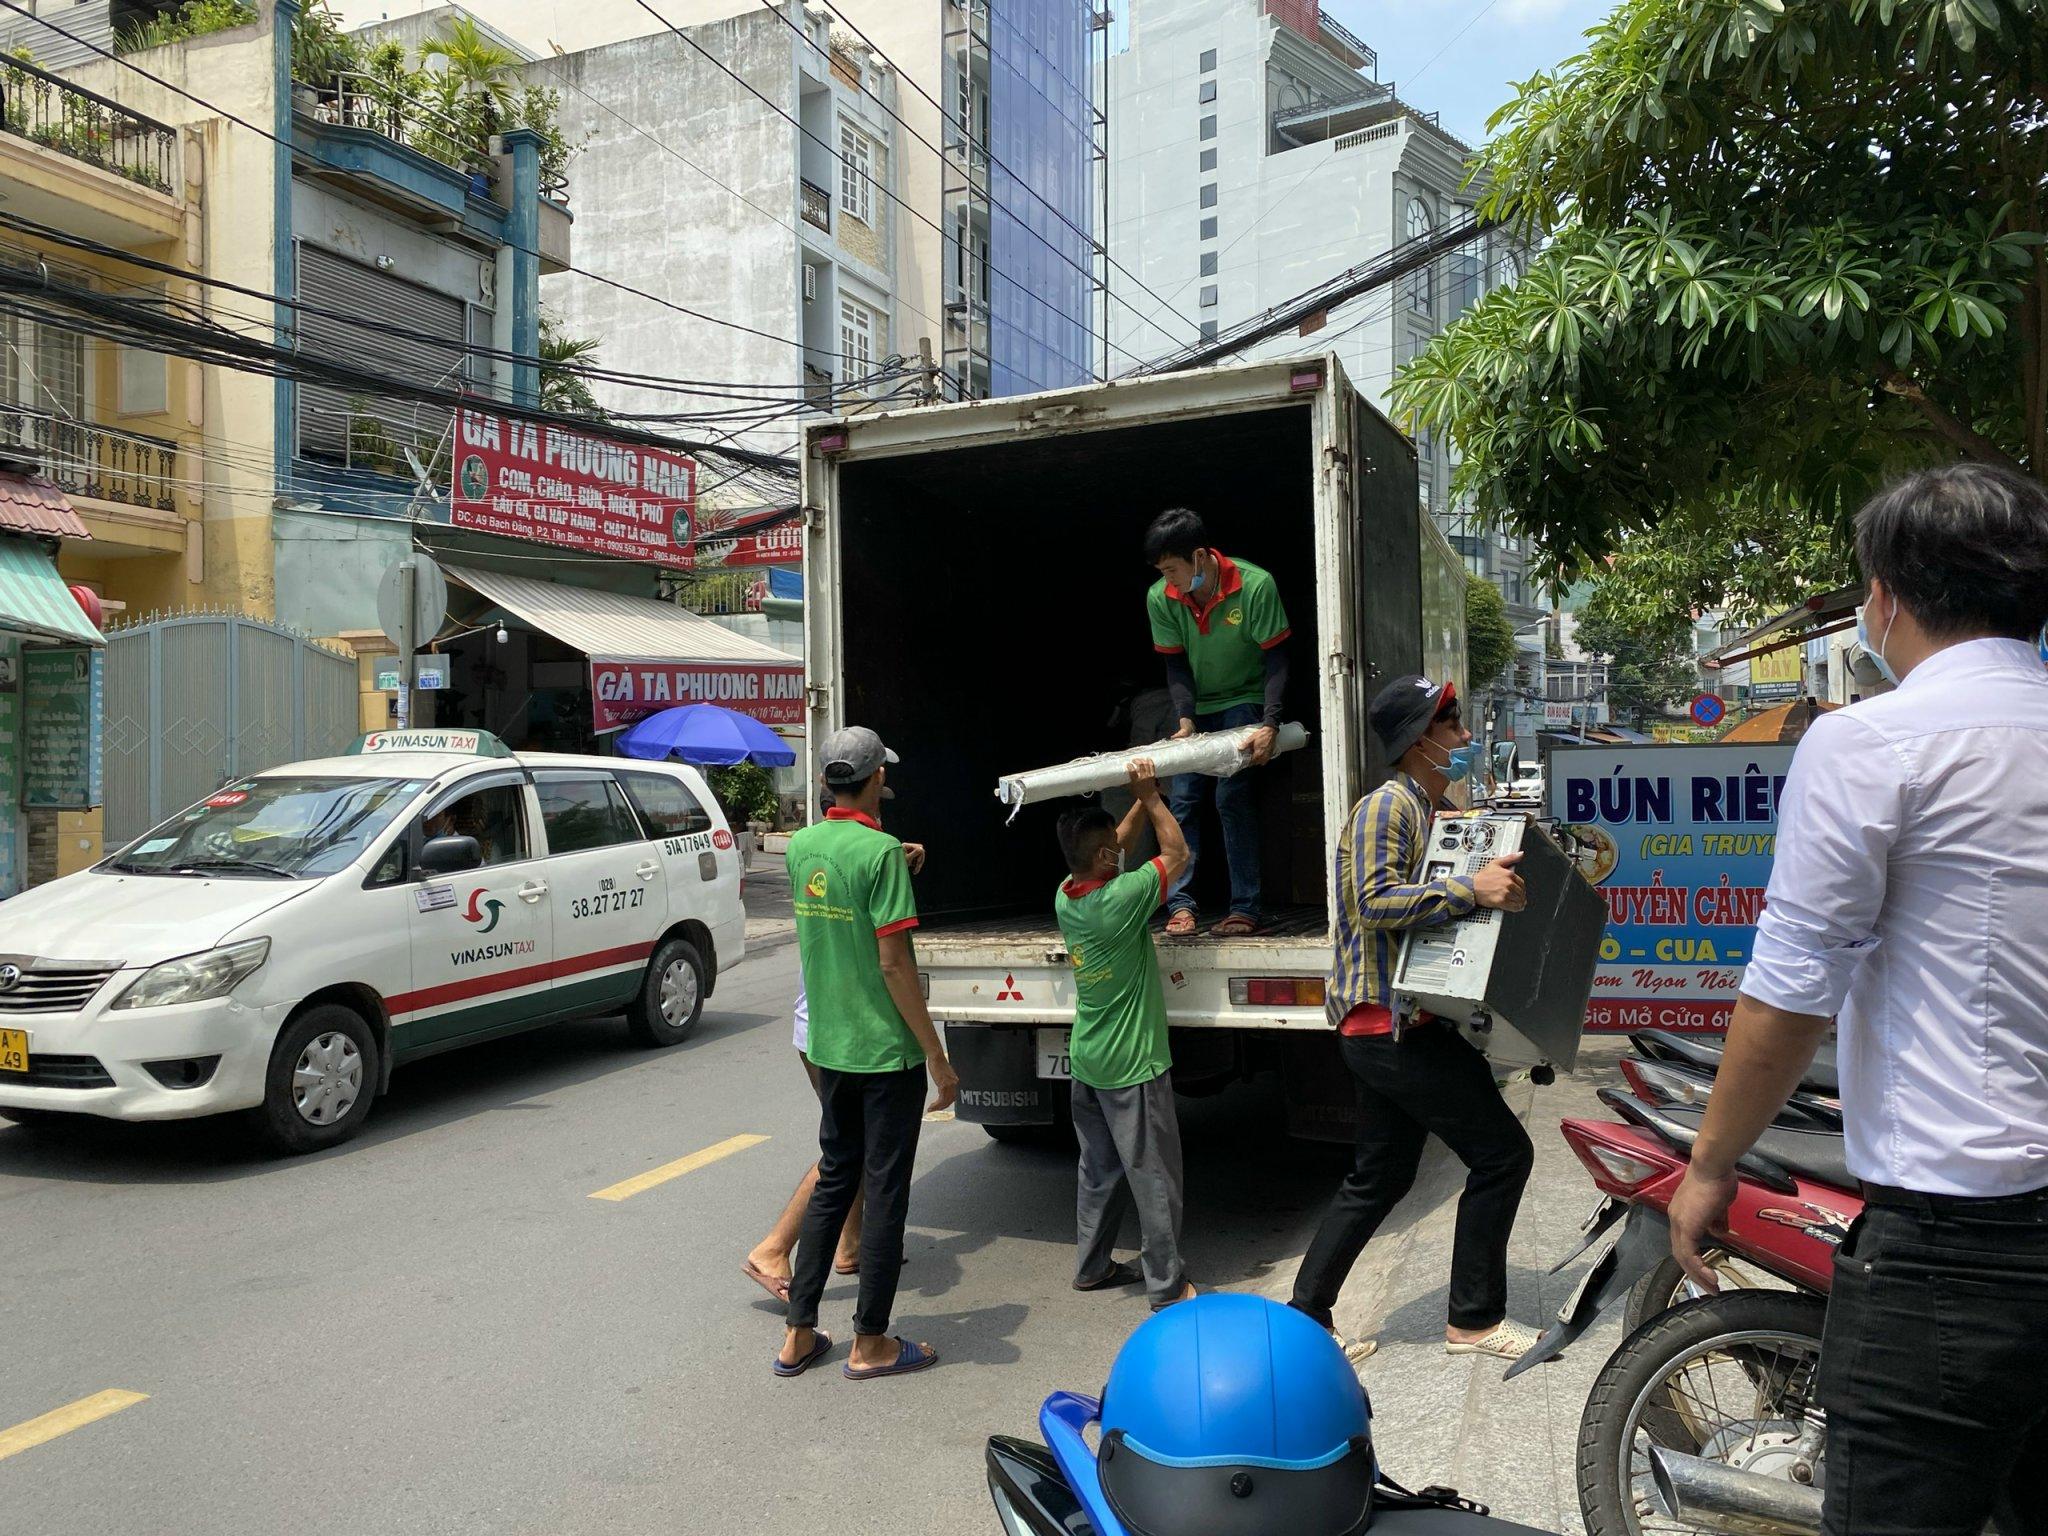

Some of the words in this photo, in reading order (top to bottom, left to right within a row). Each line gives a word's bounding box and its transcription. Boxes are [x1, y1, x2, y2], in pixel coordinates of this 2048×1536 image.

[508, 419, 539, 462] TA
[643, 455, 689, 502] NAM
[457, 510, 474, 523] ĐC:
[475, 514, 487, 525] A9
[489, 517, 510, 531] Bạch
[640, 529, 667, 547] CHANH
[597, 666, 634, 701] GÀ
[641, 672, 670, 701] TA
[763, 674, 804, 700] NAM
[390, 735, 449, 748] VINASUN
[450, 737, 476, 750] TAXI
[1566, 764, 1672, 823] BÚN
[1640, 834, 1694, 861] (GIA
[1702, 834, 1777, 858] TRUY
[598, 876, 616, 892] (028)
[572, 894, 608, 918] 38.27
[612, 891, 627, 911] 27
[630, 888, 645, 907] 27
[1656, 938, 1718, 962] CUA
[1632, 968, 1688, 994] Ngon
[1696, 969, 1738, 991] Nổi
[1619, 1005, 1653, 1026] Mở
[1659, 1006, 1705, 1027] Cửa
[2, 1032, 9, 1048] A
[960, 1089, 1039, 1107] MITSUBISHI
